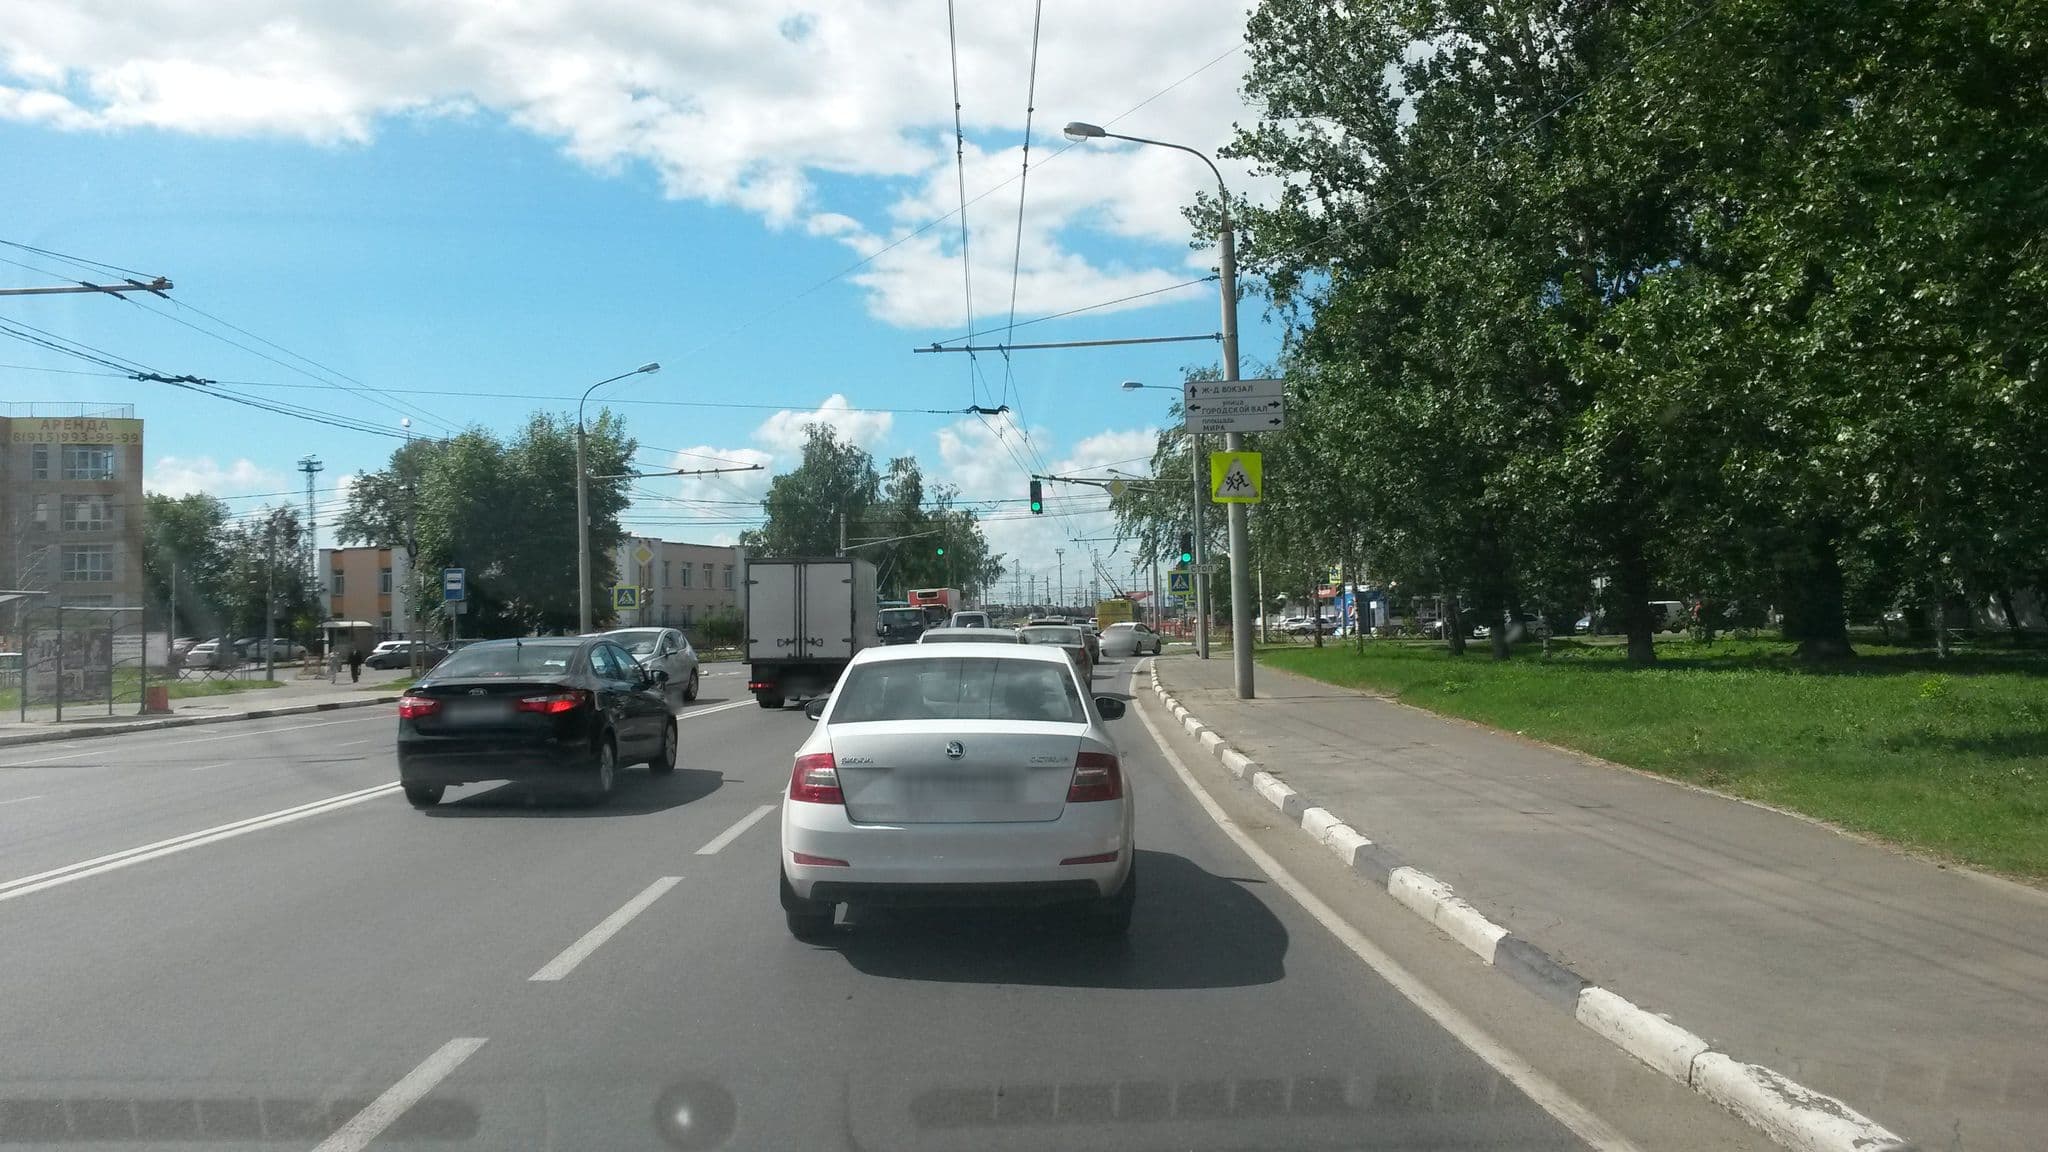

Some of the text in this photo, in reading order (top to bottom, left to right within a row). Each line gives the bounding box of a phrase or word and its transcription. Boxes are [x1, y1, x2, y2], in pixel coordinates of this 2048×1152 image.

[1201, 384, 1254, 394] Ж-Д ВОКЗАЛ
[1201, 405, 1268, 415] ГОРОДСКОЙ ВАЛ
[40, 419, 109, 432] АРЕНДА
